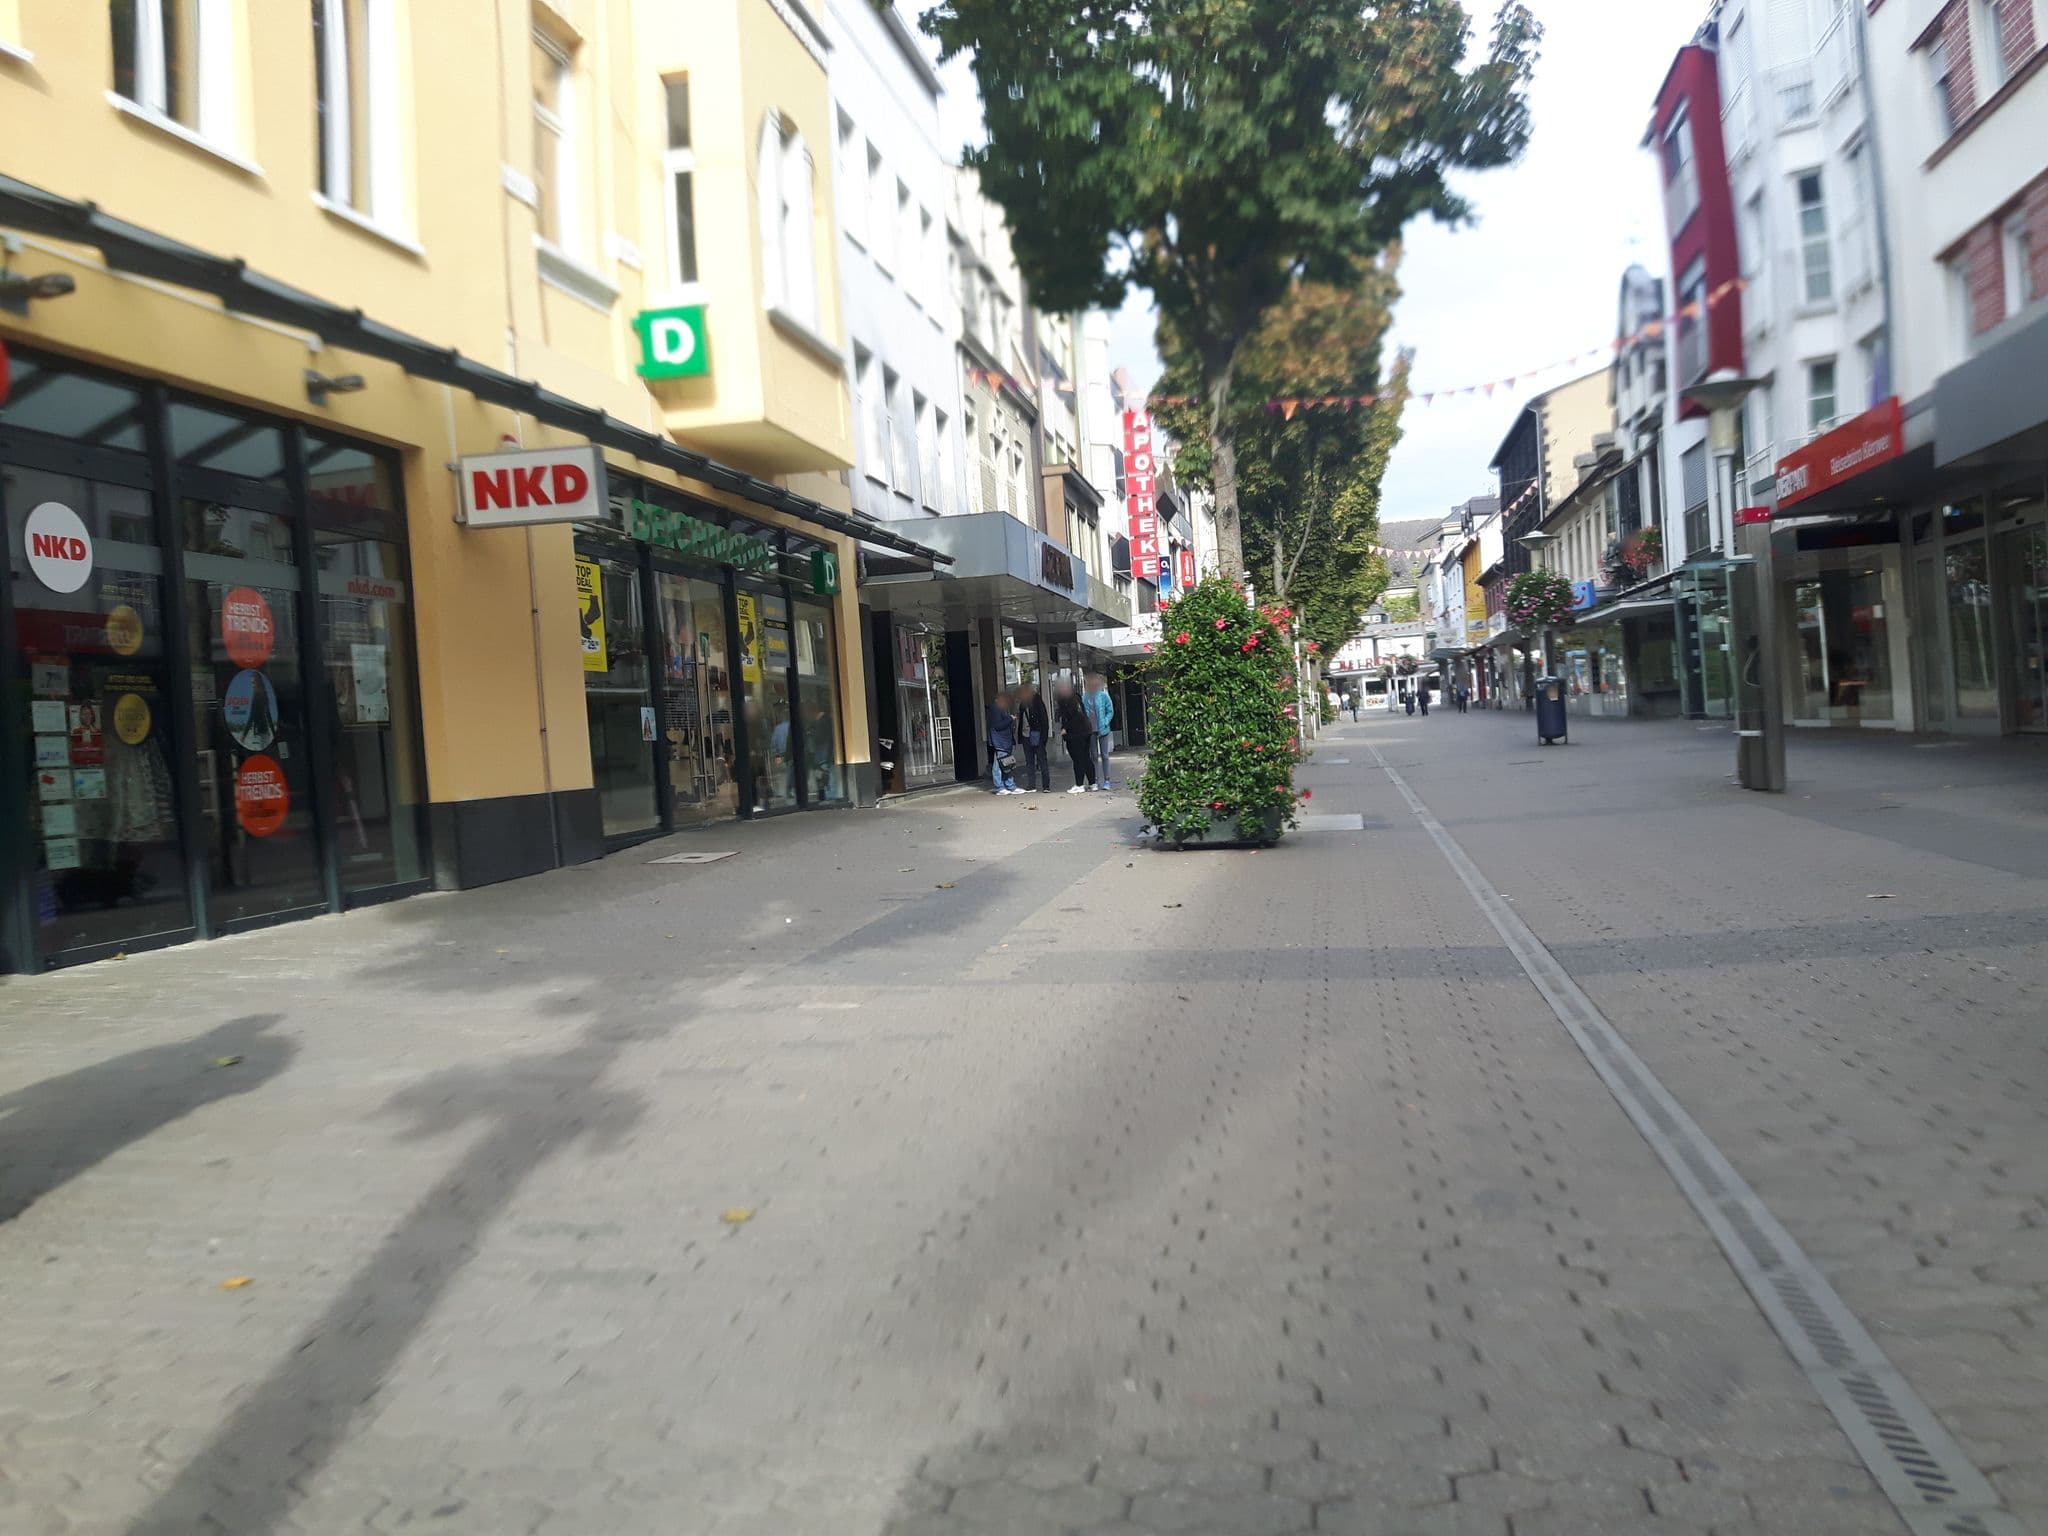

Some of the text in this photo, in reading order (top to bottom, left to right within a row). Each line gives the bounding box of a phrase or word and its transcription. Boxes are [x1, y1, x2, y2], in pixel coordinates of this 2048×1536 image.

[650, 317, 695, 364] D
[472, 464, 589, 511] NKD
[1132, 412, 1158, 576] APOTHEKE
[32, 533, 87, 561] NKD
[575, 564, 592, 578] TOP
[825, 560, 835, 587] D
[346, 579, 396, 599] nkd.com
[228, 601, 261, 617] HERBST
[225, 614, 270, 634] TRENDS
[240, 769, 275, 785] HERBST
[239, 783, 285, 800] TRENDS
